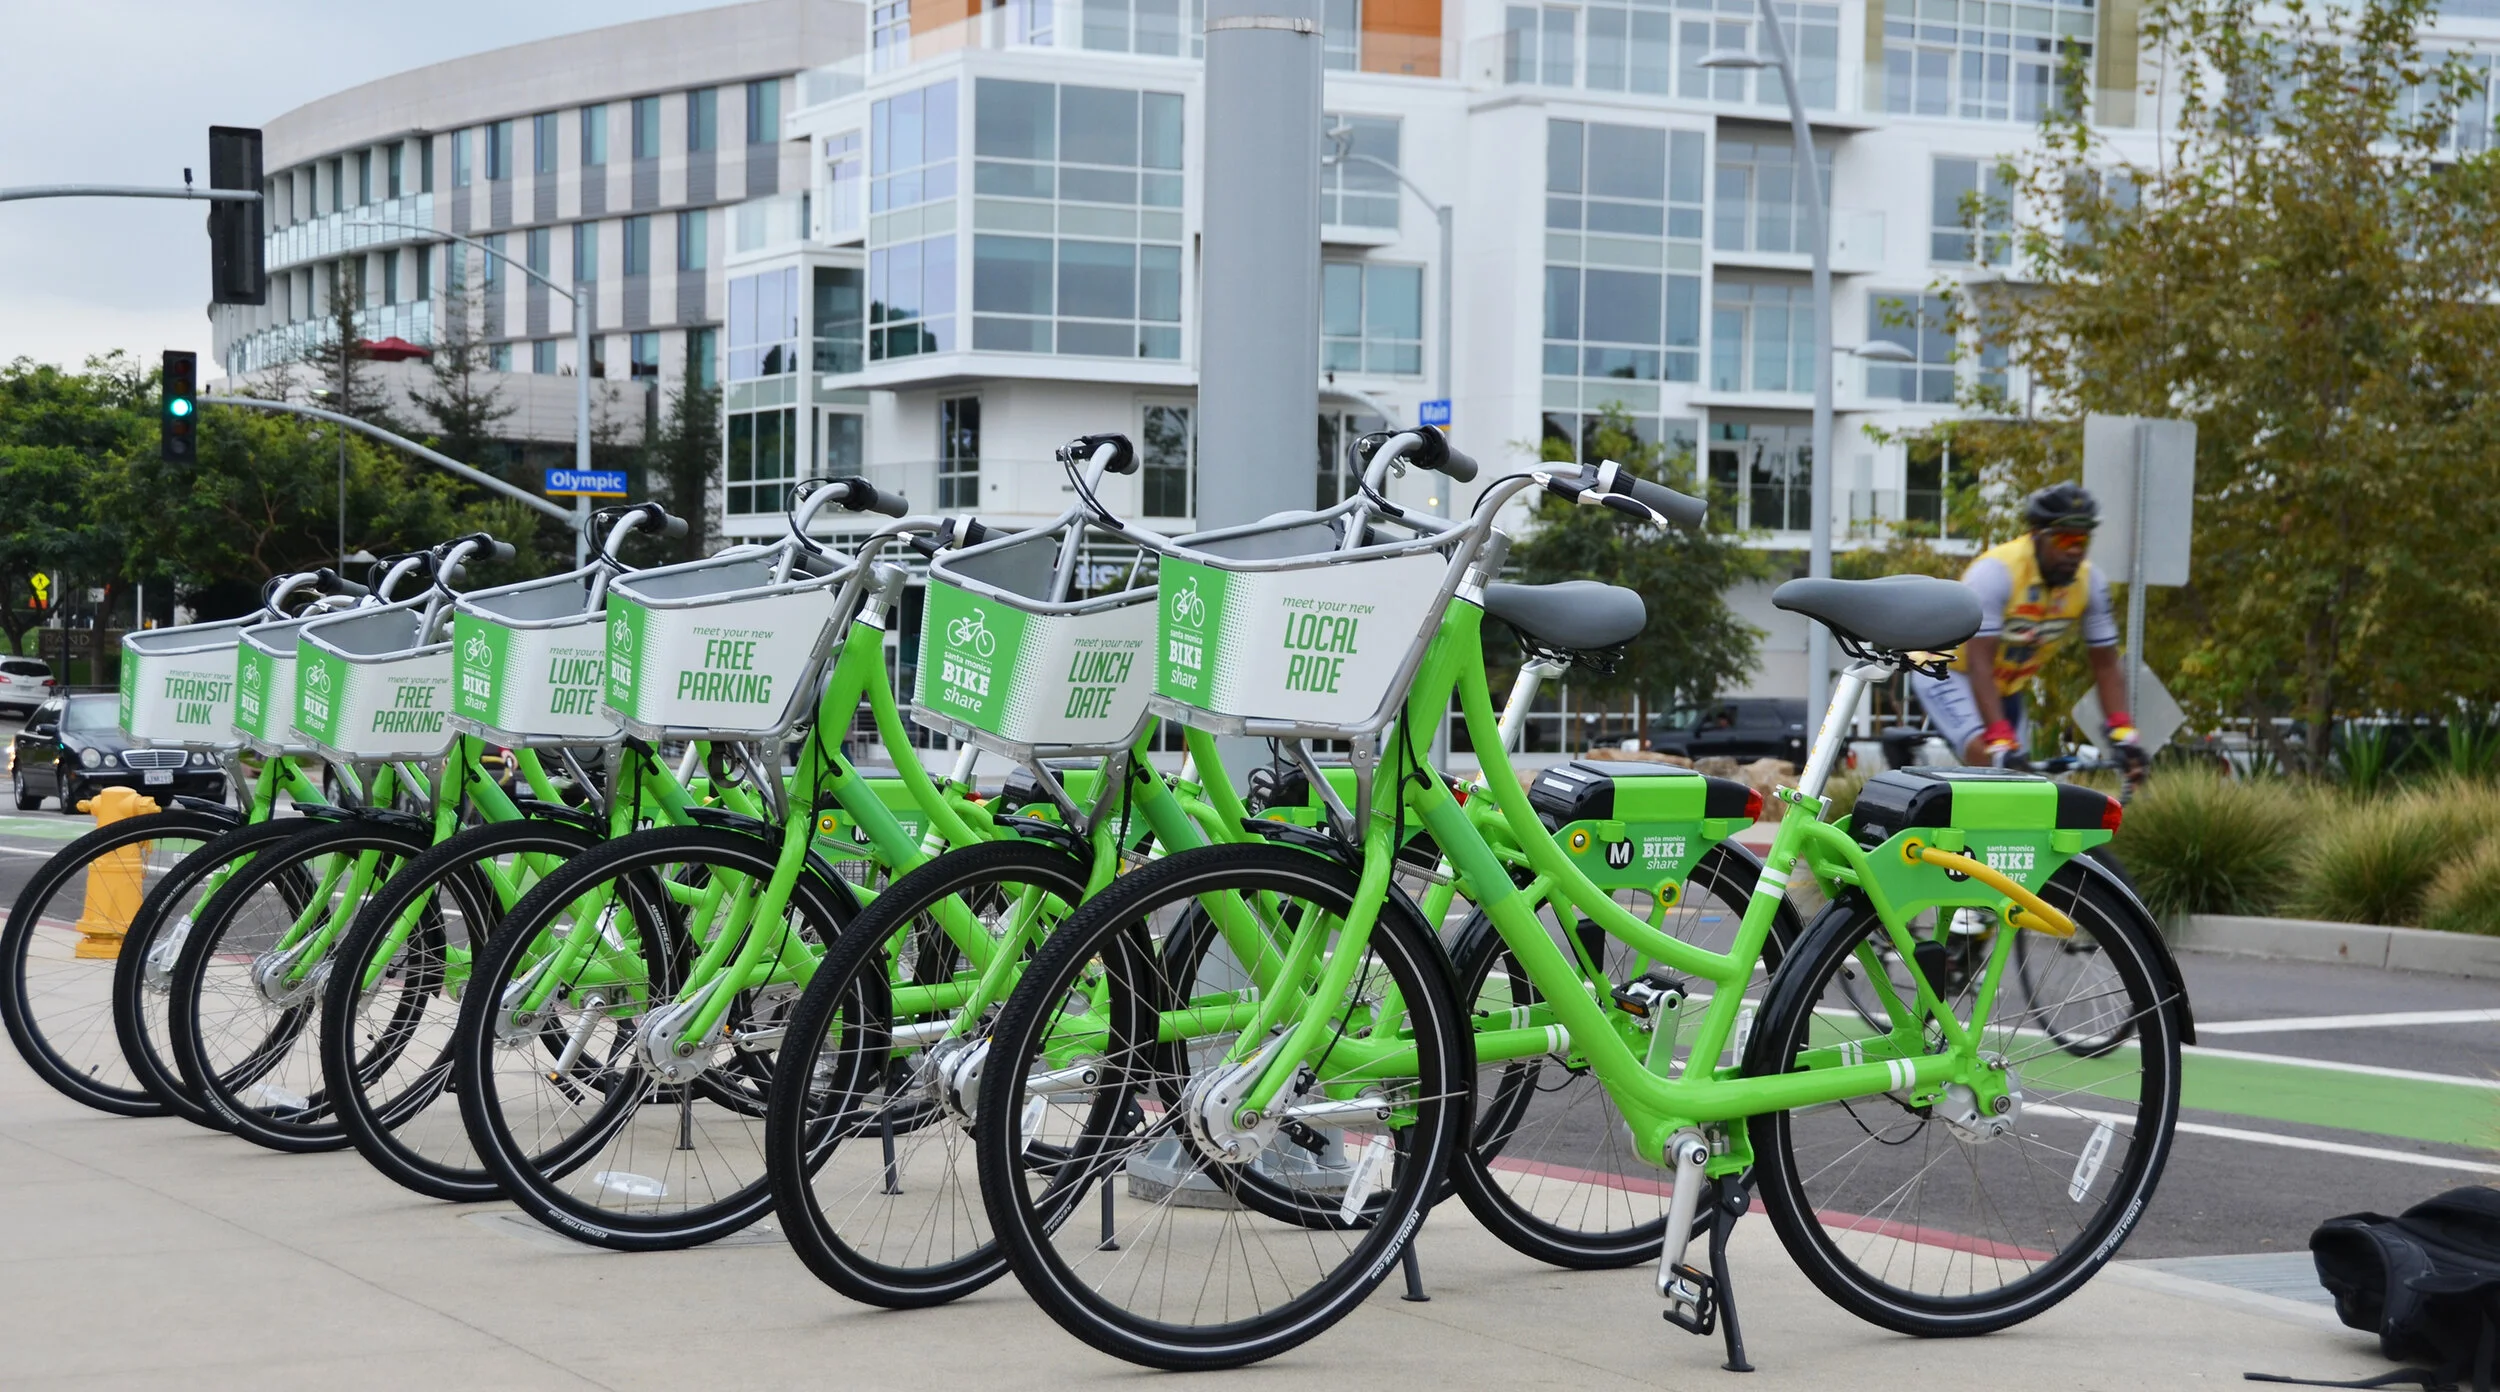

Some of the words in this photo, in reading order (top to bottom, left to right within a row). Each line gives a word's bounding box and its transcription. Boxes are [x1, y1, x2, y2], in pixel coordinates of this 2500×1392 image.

[1422, 402, 1448, 420] Main
[551, 471, 622, 491] Olympic
[1282, 596, 1313, 609] meet
[1316, 600, 1346, 613] your
[1349, 604, 1374, 614] new
[693, 626, 720, 636] meet
[723, 628, 749, 639] your
[752, 630, 774, 638] new
[1074, 638, 1098, 648] meet
[1098, 639, 1122, 648] your
[1124, 640, 1142, 648] new
[1284, 612, 1358, 654] LOCAL
[550, 647, 572, 656] meet
[574, 648, 597, 658] your
[704, 639, 756, 670] FREE
[944, 651, 964, 664] santa
[965, 658, 992, 674] monica
[1168, 640, 1202, 670] BIKE
[611, 660, 632, 686] BIKE
[941, 660, 991, 696] BIKE
[1068, 651, 1134, 684] LUNCH
[1171, 666, 1198, 690] share
[1285, 654, 1344, 694] RIDE
[165, 678, 232, 702] TRANSIT
[388, 676, 408, 684] meet
[410, 676, 430, 684] your
[462, 674, 490, 698] BIKE
[677, 670, 772, 704] PARKING
[395, 686, 435, 708] FREE
[464, 694, 488, 712] share
[550, 688, 598, 715] DATE
[612, 682, 629, 702] share
[944, 686, 982, 712] share
[1065, 687, 1116, 718] DATE
[176, 702, 213, 724] LINK
[242, 694, 260, 716] BIKE
[304, 695, 328, 720] BIKE
[304, 714, 326, 732] share
[372, 710, 444, 732] PARKING
[1610, 842, 1630, 864] M
[1642, 843, 1686, 858] BIKE
[1986, 852, 2034, 870] BIKE
[1646, 858, 1678, 870] share
[650, 904, 672, 954] KENDATIRE.COM
[548, 1210, 608, 1239] KENDATIRE.COM
[2096, 1198, 2142, 1260] KENDATIRE.COM
[1371, 1210, 1420, 1280] KENDATIRE.COM
